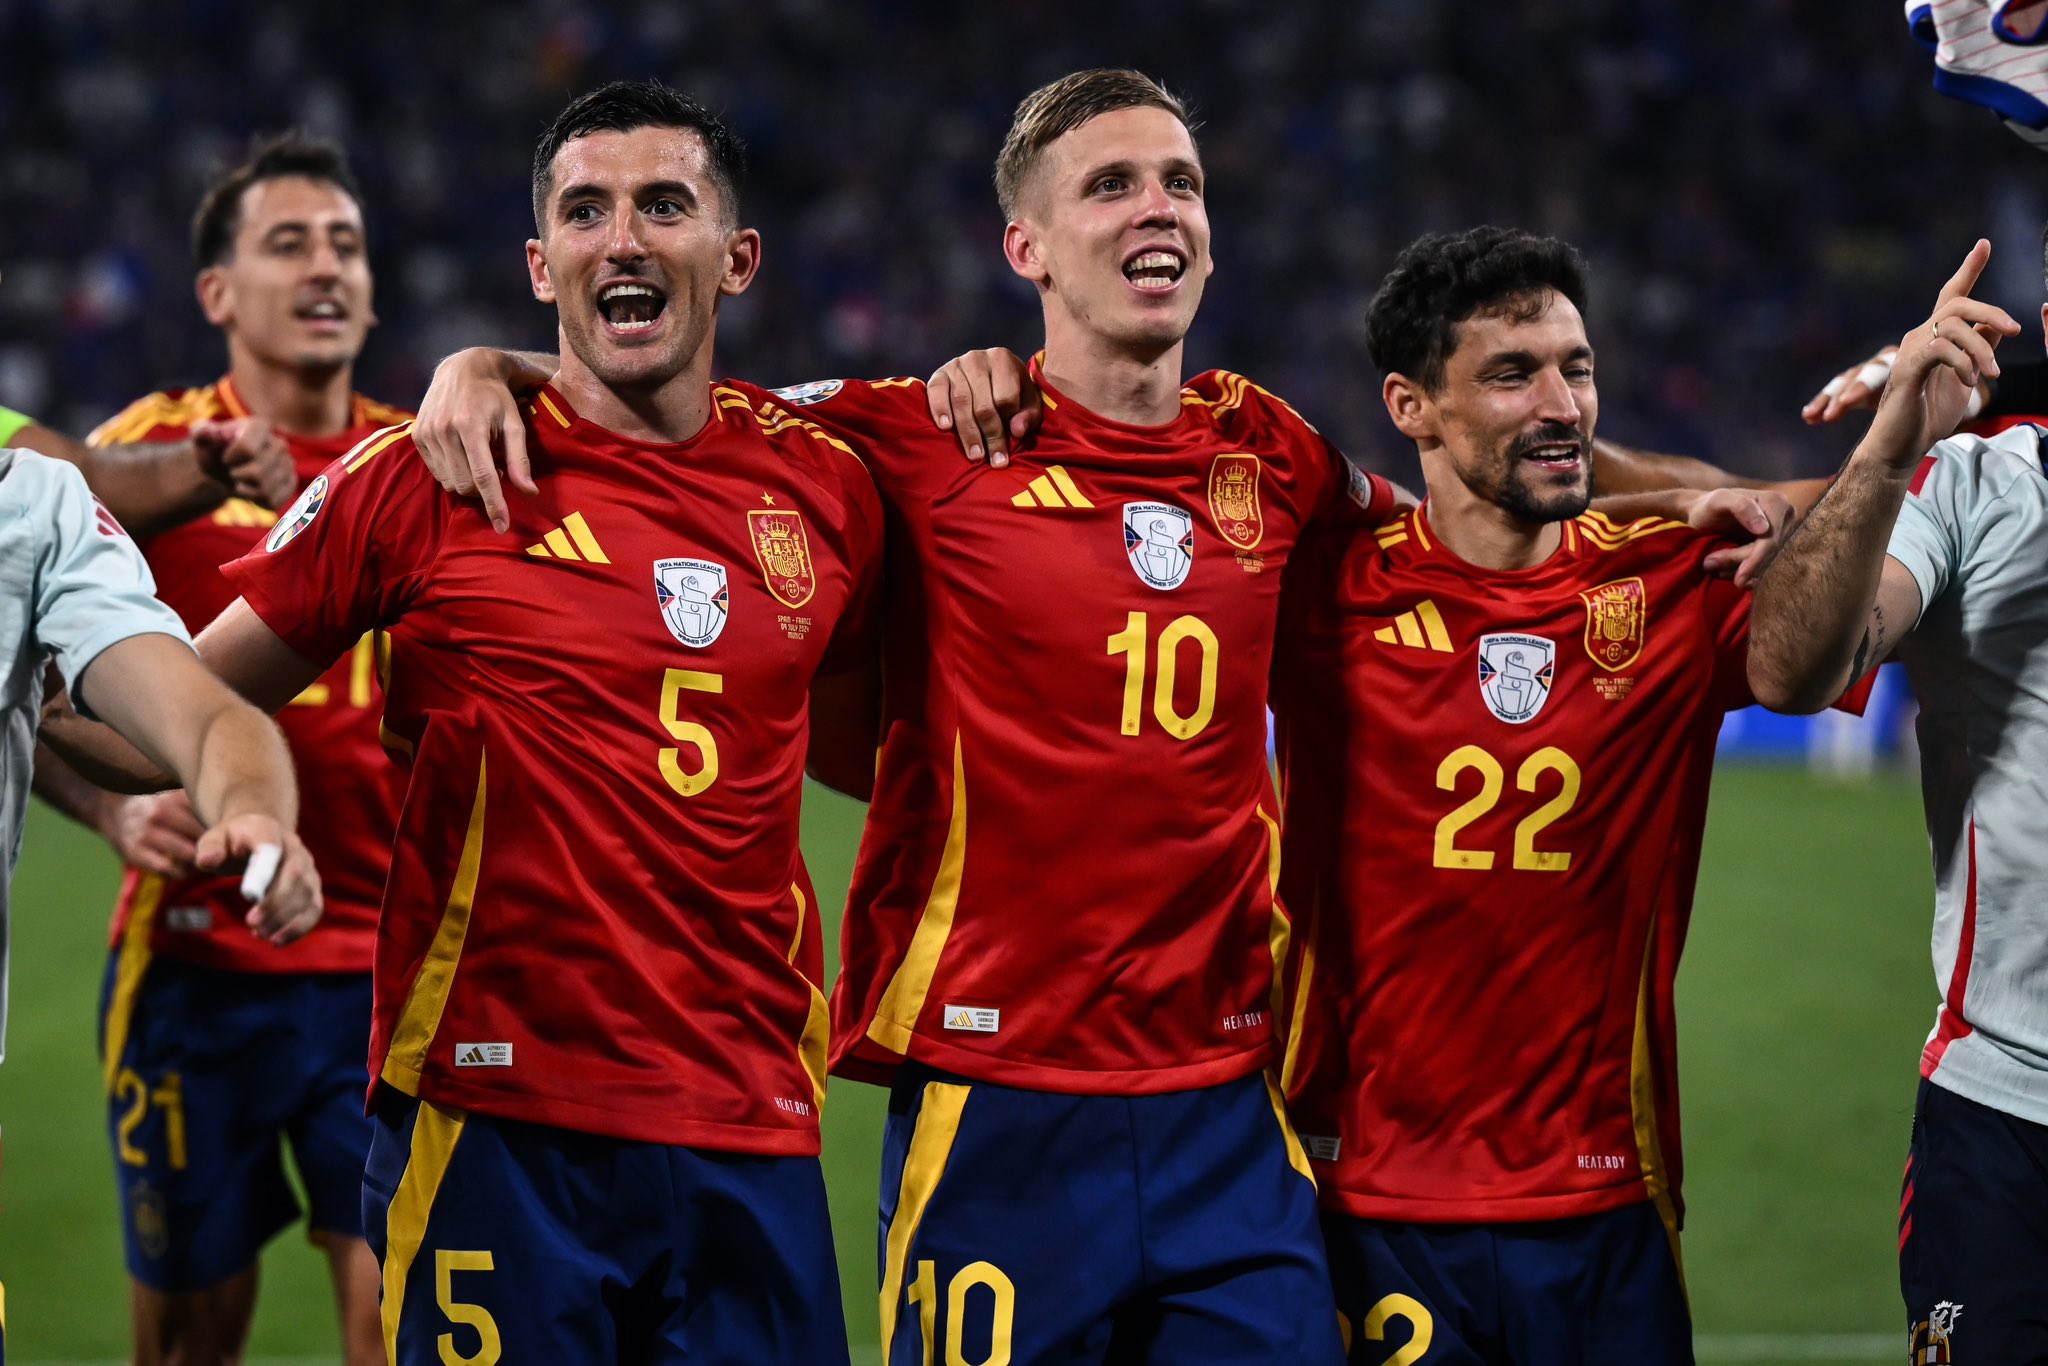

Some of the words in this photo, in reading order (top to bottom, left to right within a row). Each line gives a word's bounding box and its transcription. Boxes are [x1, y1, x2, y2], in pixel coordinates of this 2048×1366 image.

[700, 563, 722, 573] LEAGUE
[678, 632, 699, 644] WINNER
[1107, 611, 1219, 741] 10
[1528, 639, 1550, 648] LEAGUE
[658, 668, 723, 797] 5
[1433, 744, 1581, 871] 22
[116, 1068, 187, 1170] 21
[1577, 1154, 1625, 1170] HEAT.RDY
[435, 1249, 502, 1366] 5
[907, 1259, 1015, 1366] 10
